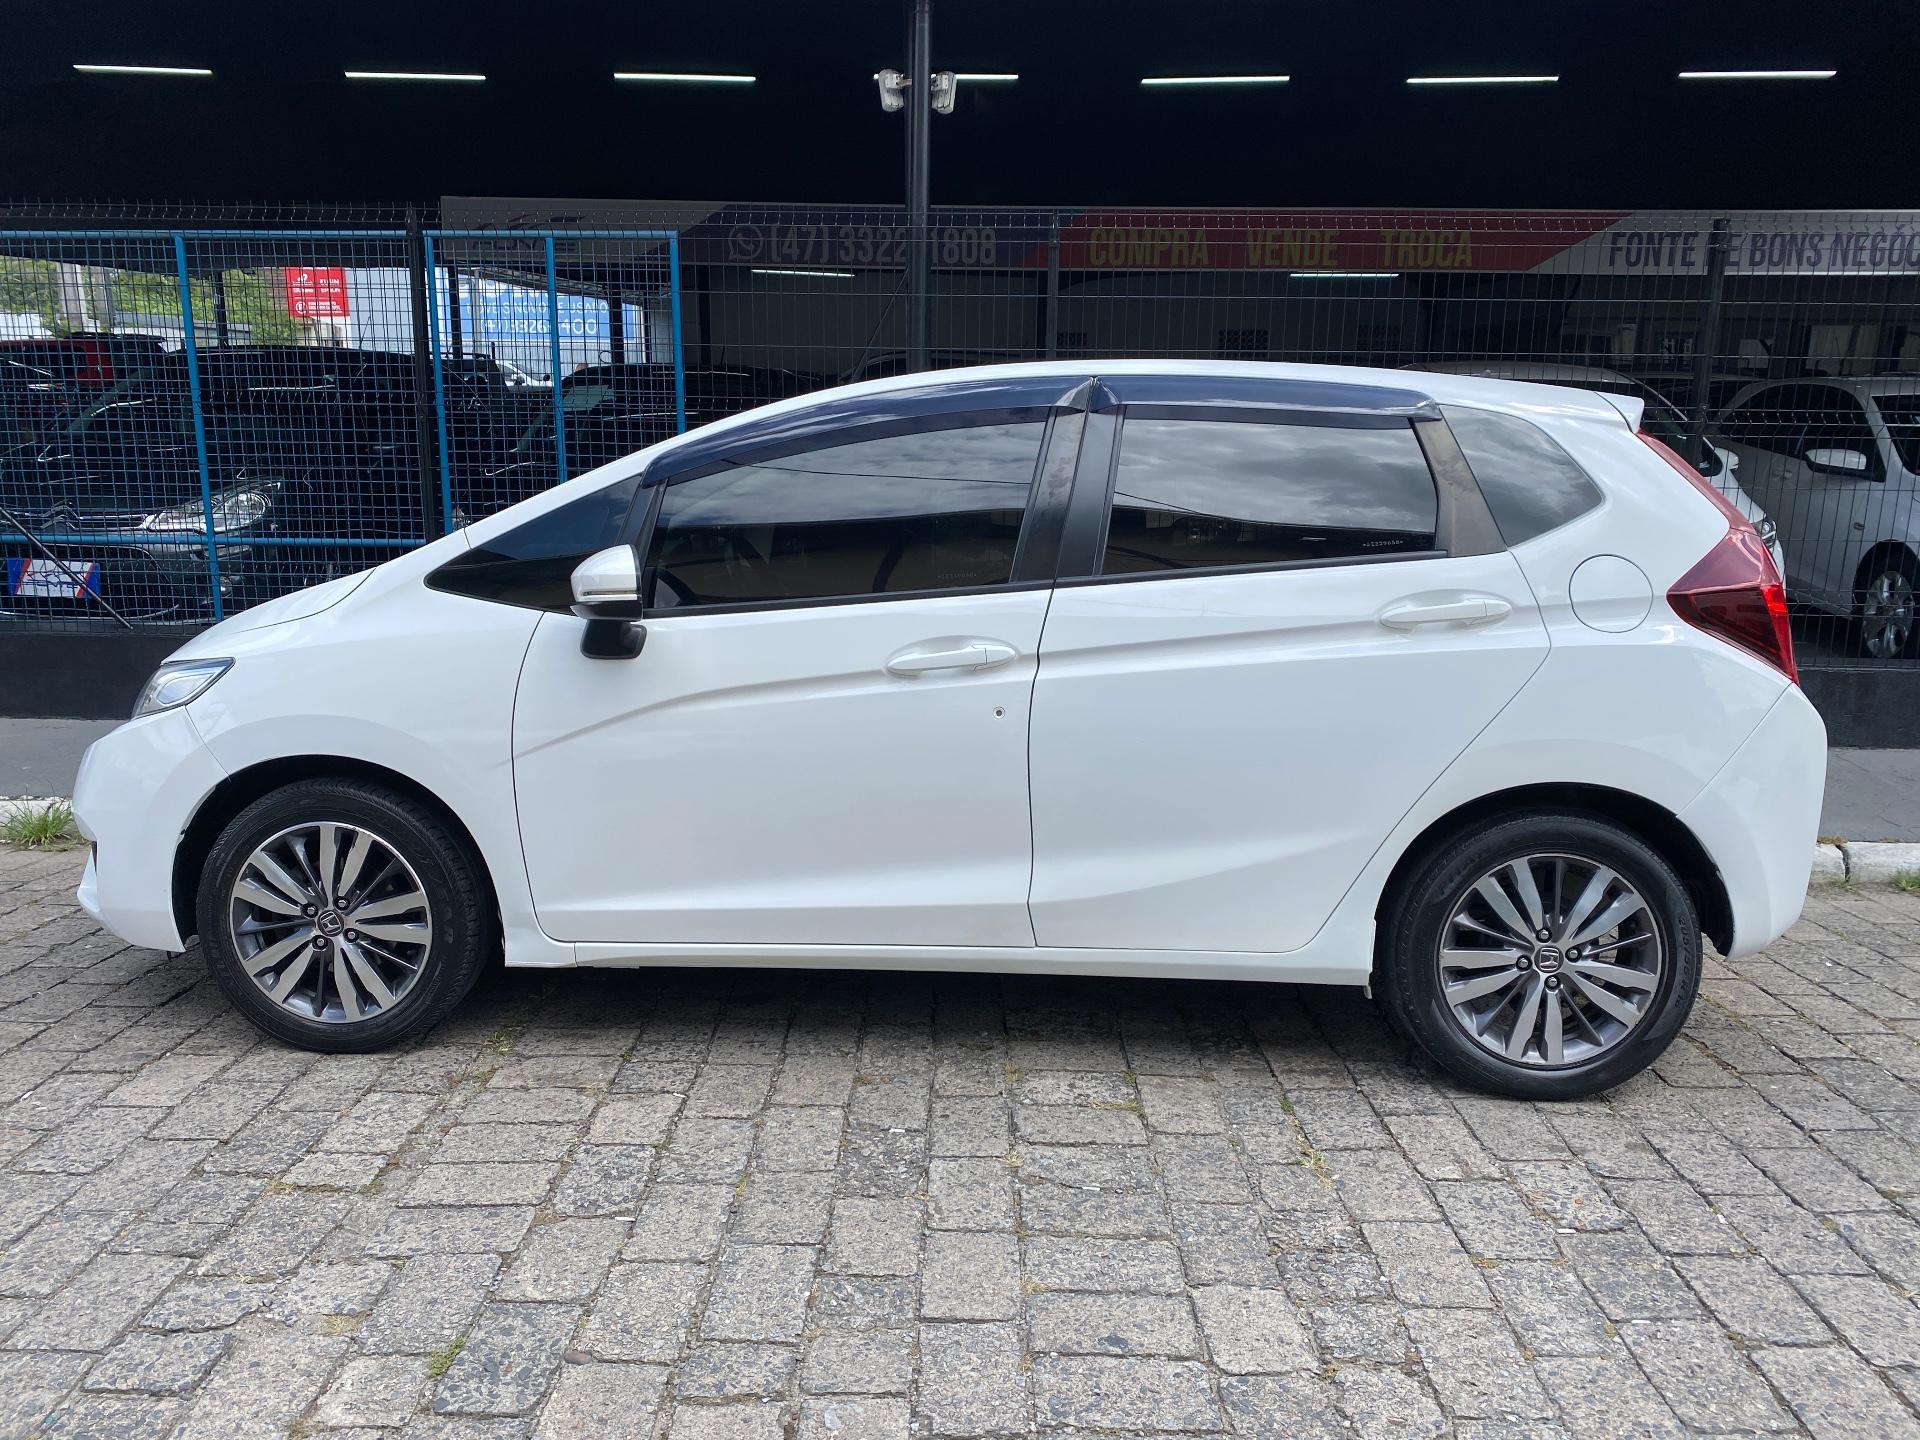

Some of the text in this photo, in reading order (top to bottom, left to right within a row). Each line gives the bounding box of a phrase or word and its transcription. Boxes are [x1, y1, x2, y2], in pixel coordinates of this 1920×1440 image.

[771, 226, 830, 263] (47)
[930, 227, 996, 265] 1808
[1089, 229, 1473, 268] COMPRA VENDE TROCA
[1607, 231, 1699, 267] FONTE
[1706, 232, 1744, 267] E
[1748, 232, 1825, 267] BONS
[514, 302, 548, 314] NOVO
[569, 301, 609, 314] USADO
